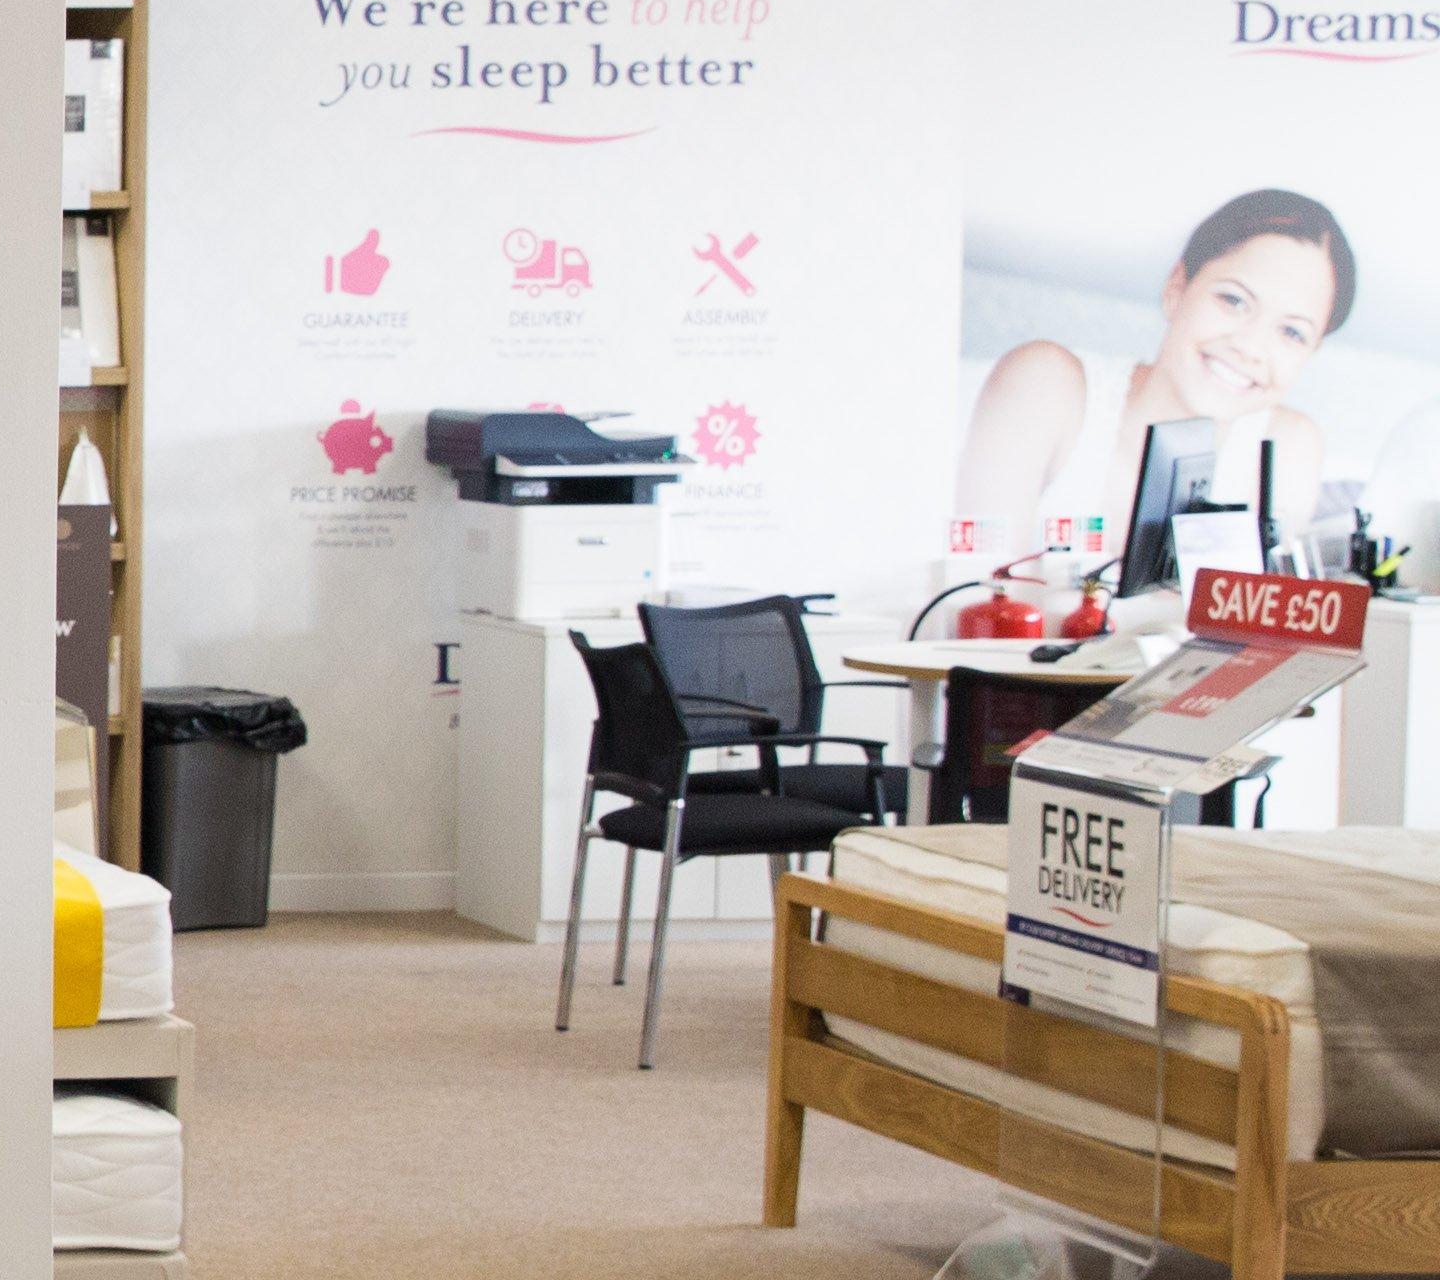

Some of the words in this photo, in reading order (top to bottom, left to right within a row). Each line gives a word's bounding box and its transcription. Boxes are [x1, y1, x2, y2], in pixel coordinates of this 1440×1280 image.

[1233, 0, 1440, 45] Dreams
[318, 60, 413, 108] you
[430, 45, 571, 106] sleep
[591, 43, 755, 89] better
[302, 310, 410, 330] GUARANTEE
[508, 309, 584, 328] DELIVERY
[683, 308, 770, 326] ASSEMBLY
[290, 485, 336, 503] PRICE
[343, 485, 418, 503] PROMISE
[1207, 576, 1281, 628] SAVE
[1285, 585, 1344, 636] £50
[1039, 801, 1126, 879] FREE
[1038, 865, 1127, 915] DELIVERY
